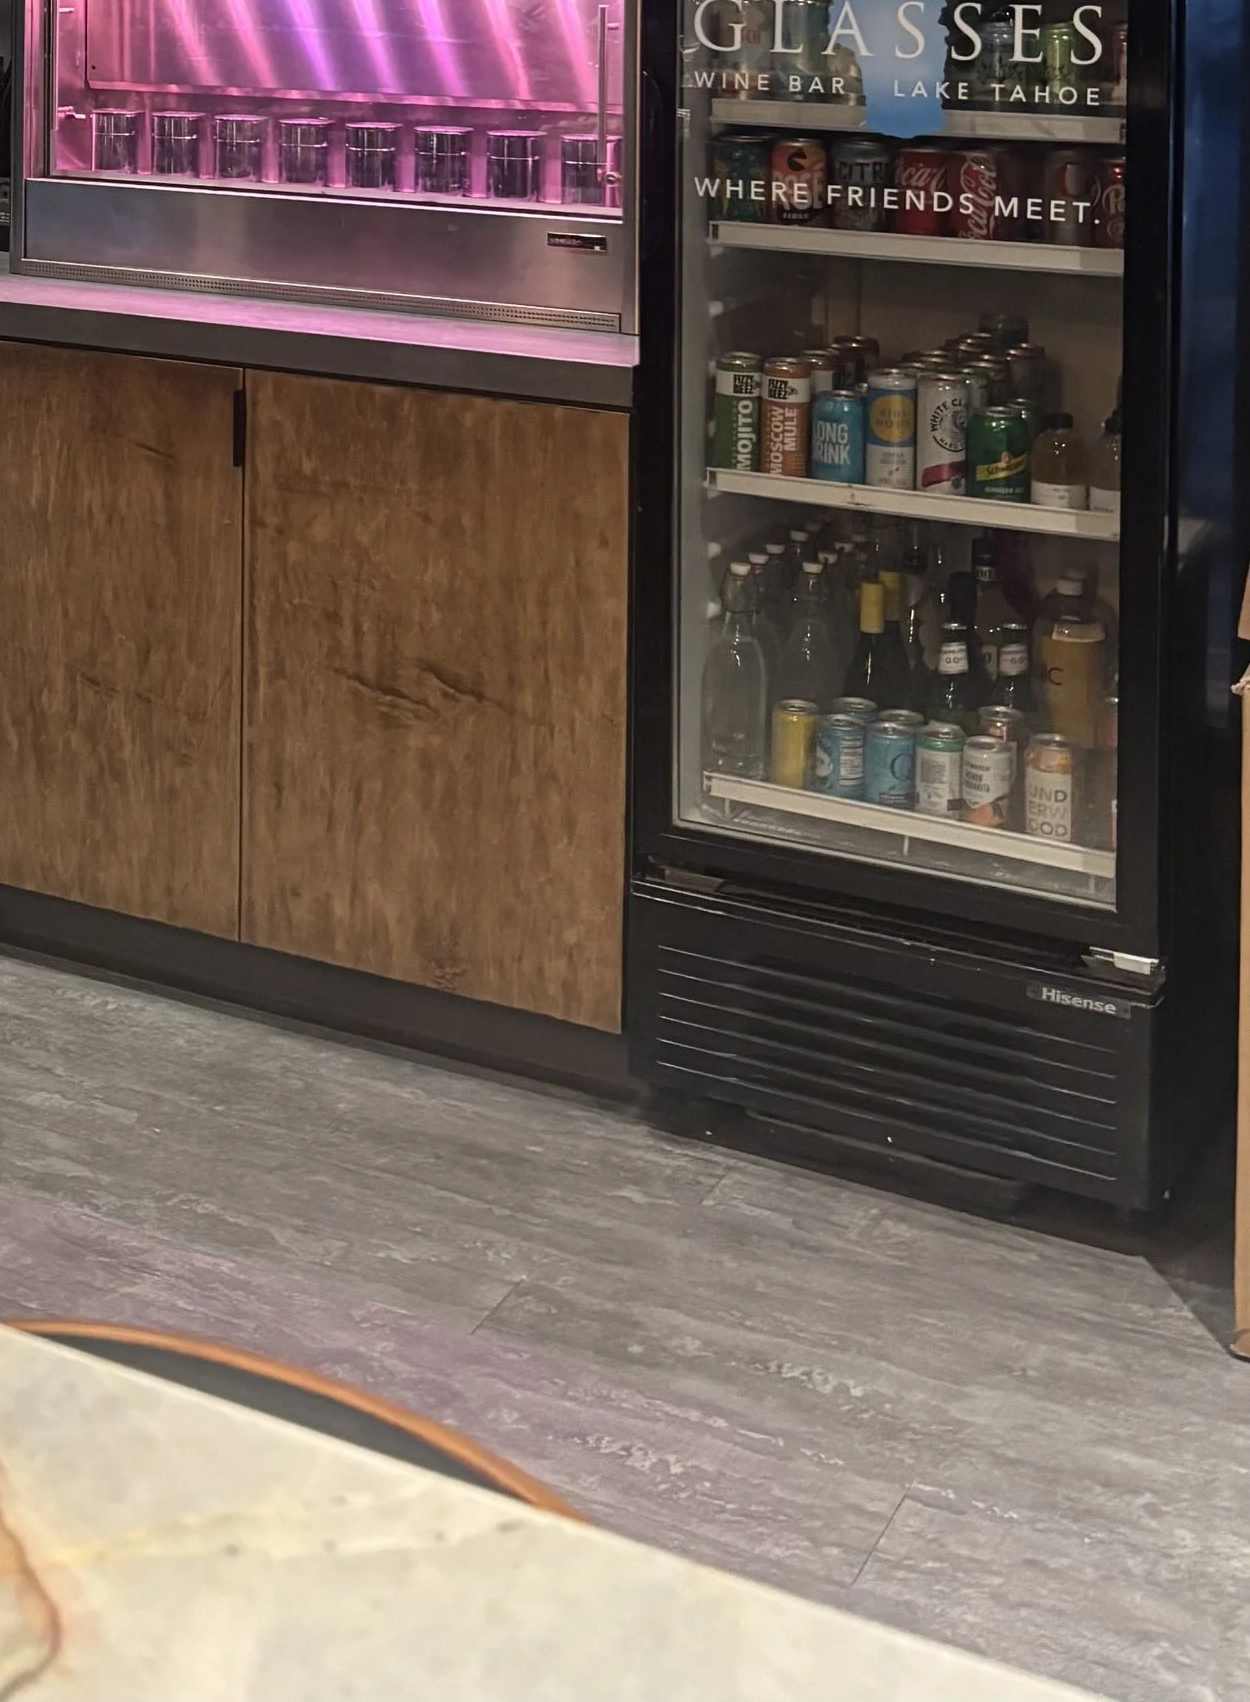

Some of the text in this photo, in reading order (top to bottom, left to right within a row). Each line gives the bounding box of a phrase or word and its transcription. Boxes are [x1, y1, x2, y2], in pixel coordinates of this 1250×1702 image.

[695, 71, 846, 94] WINE BAR
[894, 79, 1101, 106] LAKE TAHOE
[694, 177, 809, 204] WHERE
[827, 184, 974, 215] FRIENDS
[994, 195, 1100, 225] MEET.
[733, 384, 754, 394] BEEZ
[734, 374, 755, 385] FIZZY
[768, 378, 789, 390] FIZZY
[768, 388, 788, 399] BEEZ
[930, 397, 967, 433] WHITE CL
[737, 400, 756, 471] MOJITO
[770, 406, 784, 476] MOSCOW
[783, 408, 797, 452] MULE
[1041, 986, 1117, 1014] Hisense
